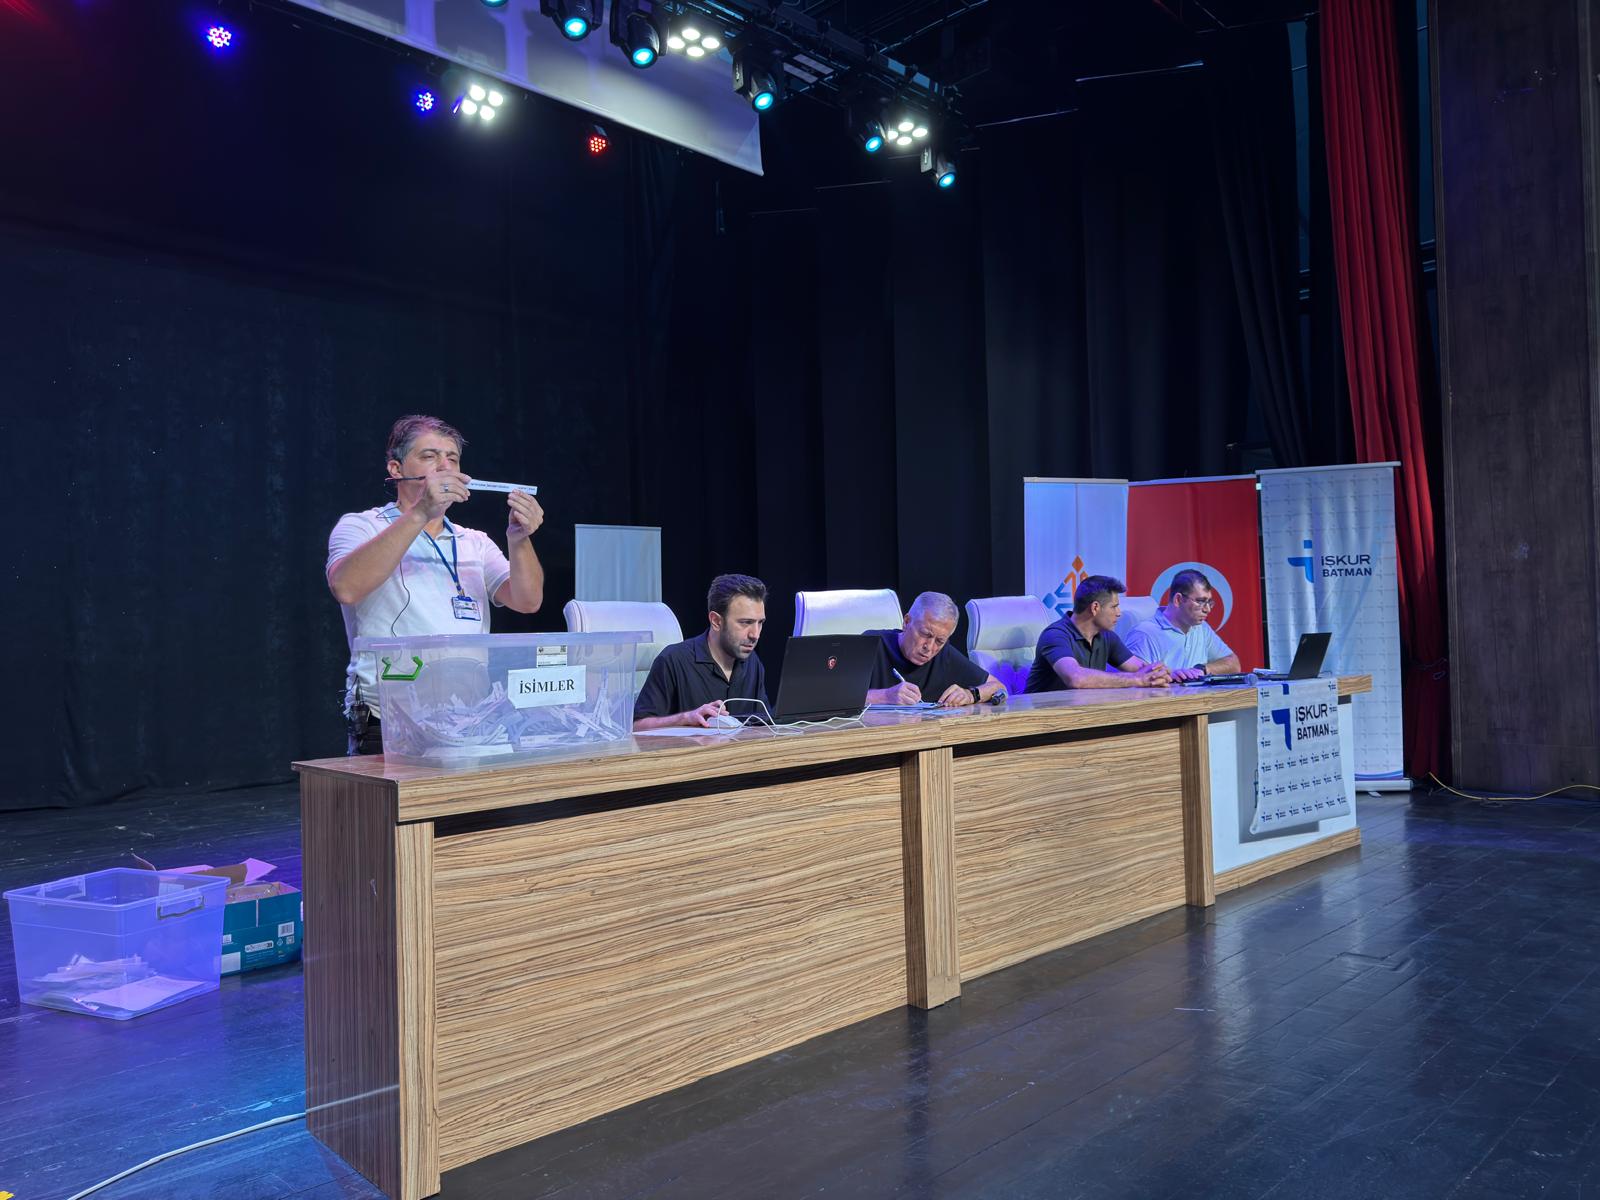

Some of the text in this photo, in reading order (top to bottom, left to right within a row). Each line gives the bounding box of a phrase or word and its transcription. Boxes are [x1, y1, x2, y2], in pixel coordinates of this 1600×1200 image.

[1322, 567, 1372, 577] BATMAN
[519, 678, 575, 694] İSİMLER
[1297, 723, 1330, 740] BATMAN
